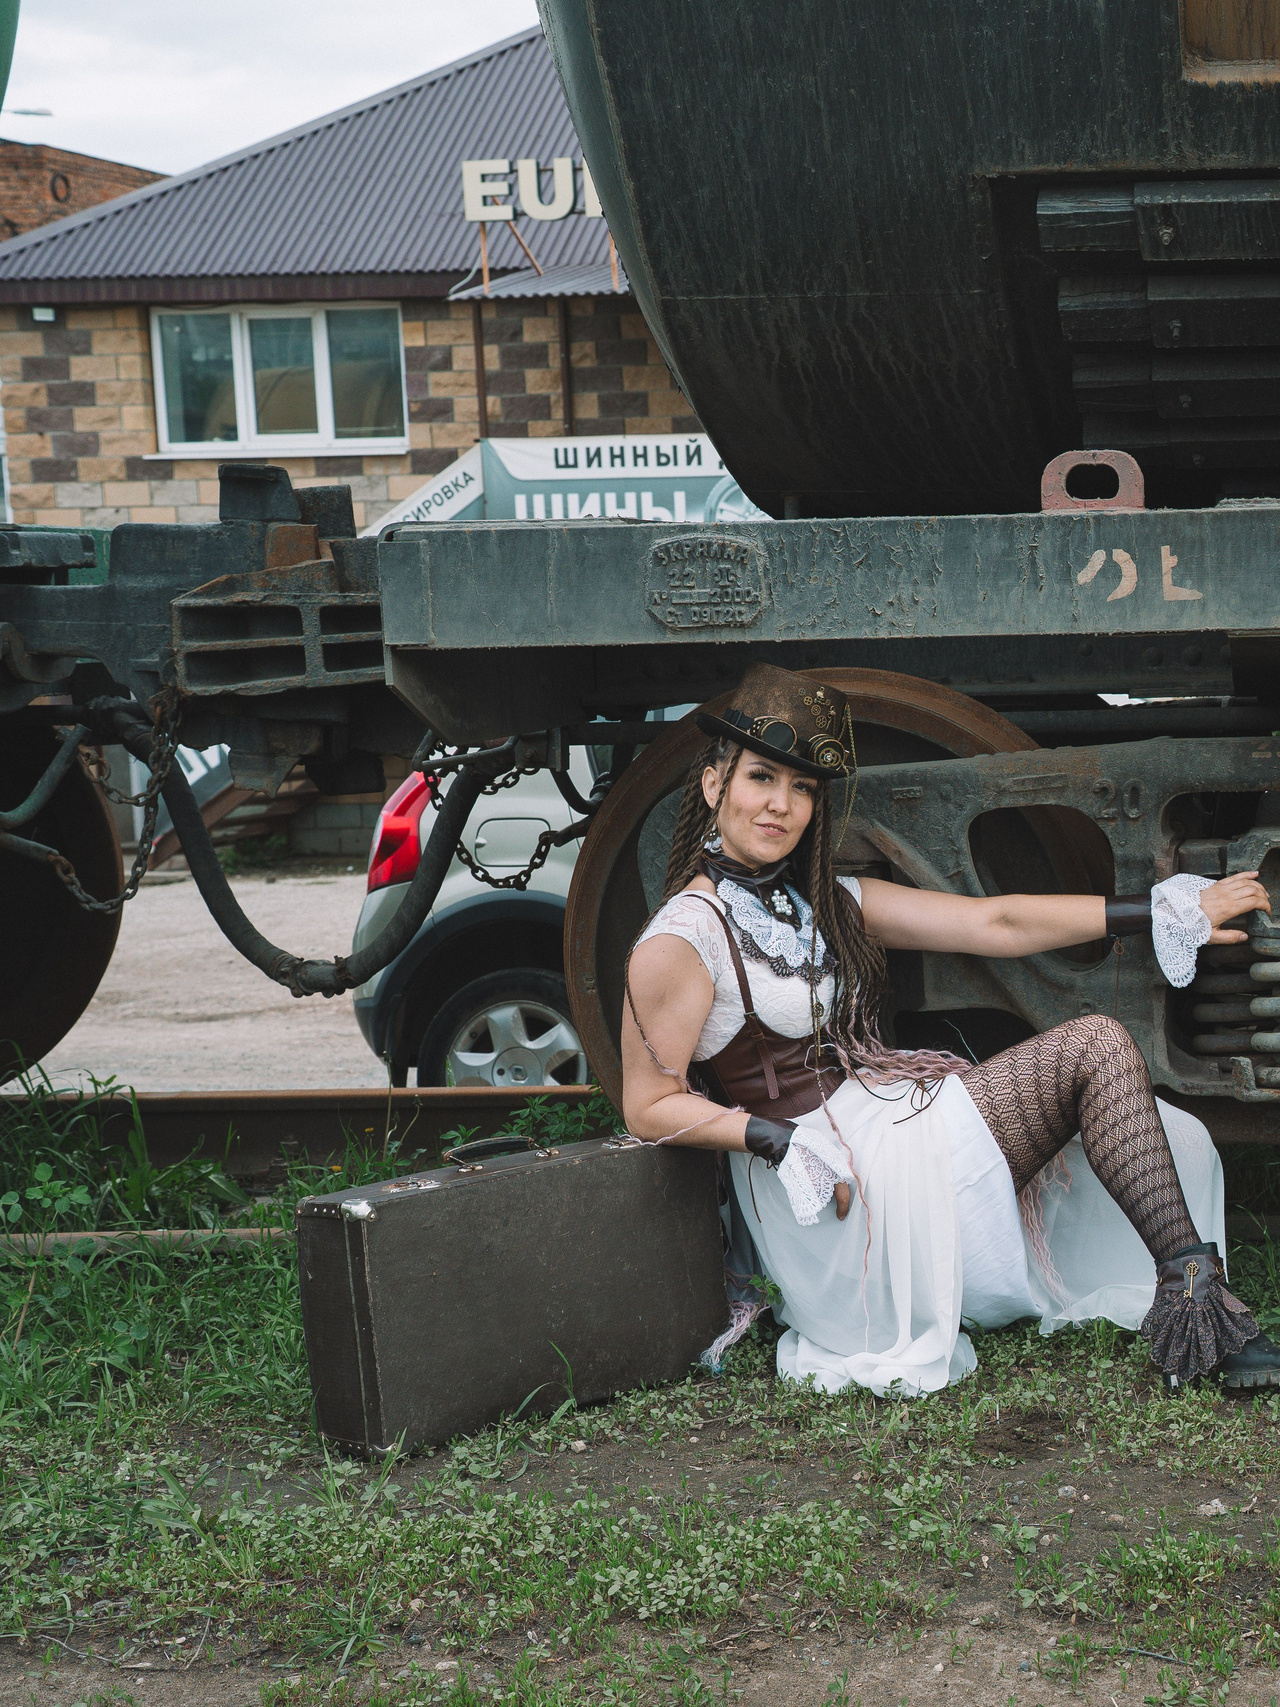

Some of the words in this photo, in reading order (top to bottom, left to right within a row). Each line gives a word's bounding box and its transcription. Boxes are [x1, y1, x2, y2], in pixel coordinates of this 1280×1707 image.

[554, 438, 702, 469] ШИННЫЙ
[514, 491, 686, 522] ШИНЫ
[669, 568, 695, 587] 22
